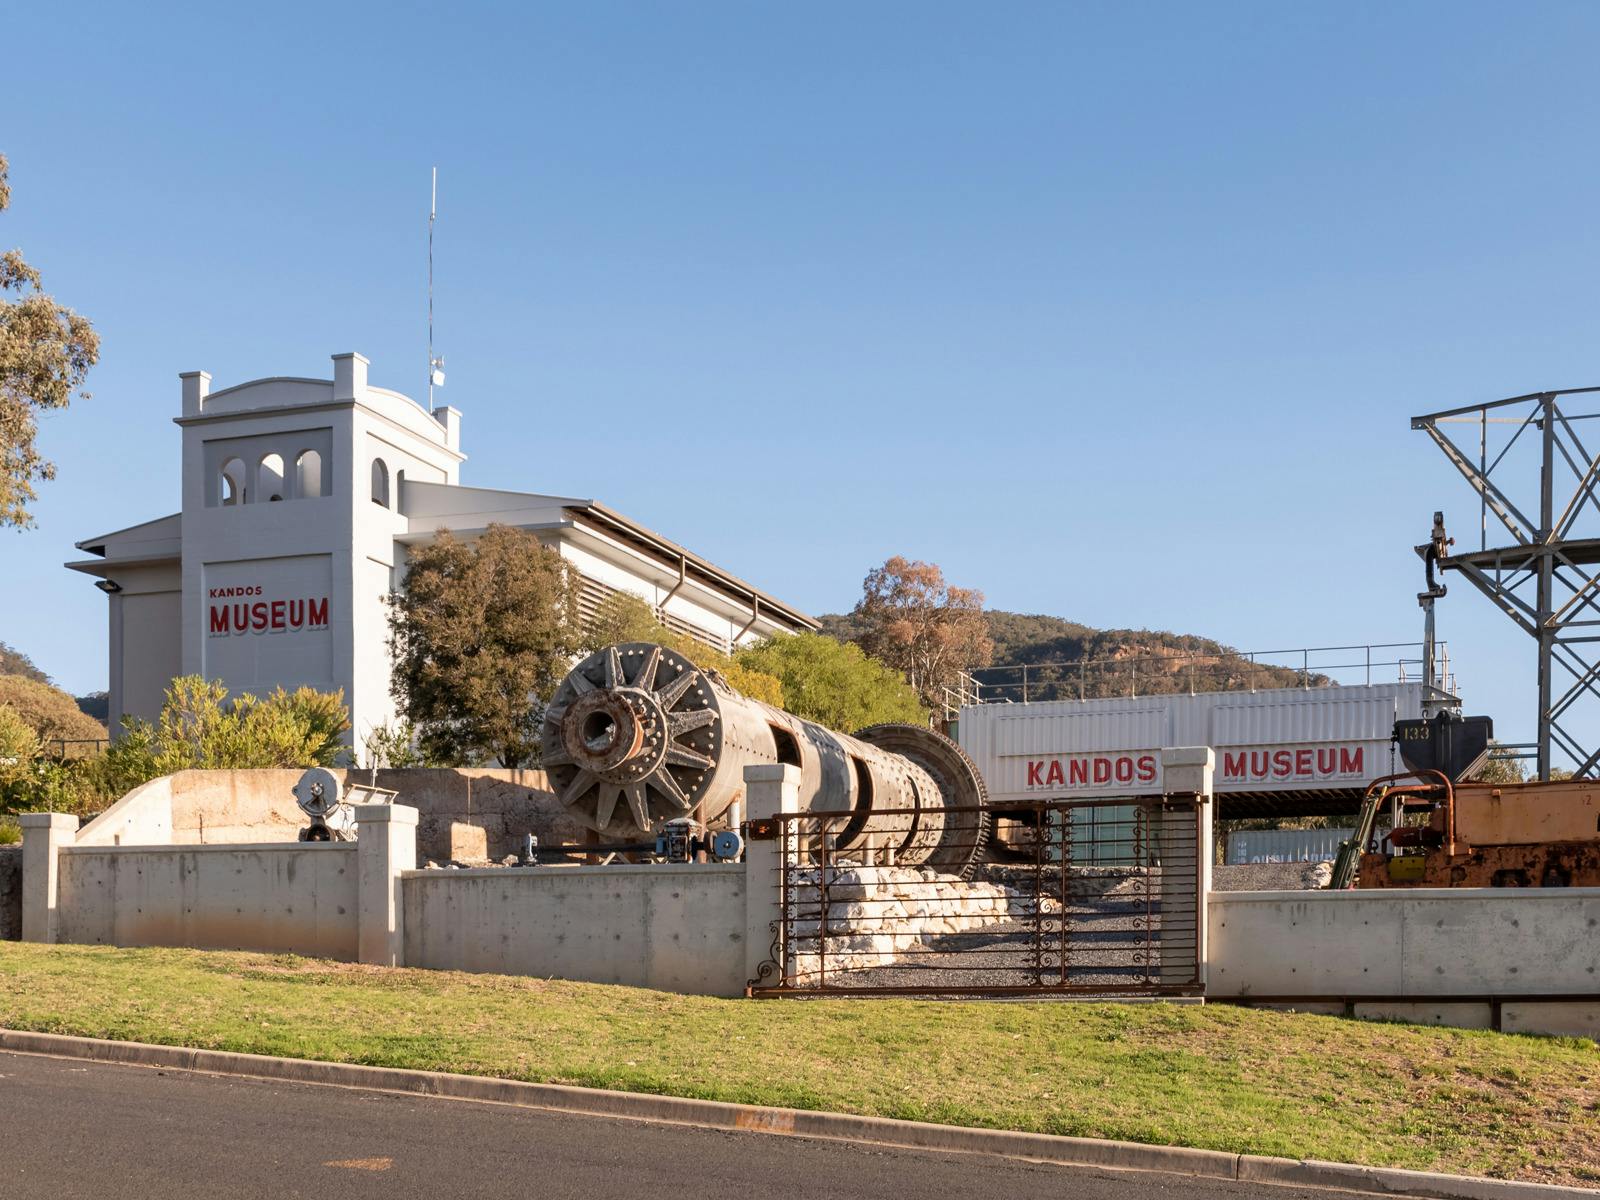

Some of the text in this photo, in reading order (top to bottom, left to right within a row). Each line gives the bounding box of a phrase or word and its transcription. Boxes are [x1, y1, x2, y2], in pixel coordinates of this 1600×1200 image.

[209, 586, 263, 598] KANDOS
[210, 597, 329, 633] MUSEUM
[1404, 727, 1430, 740] 133
[1027, 746, 1364, 786] KANDOS MUSEUM
